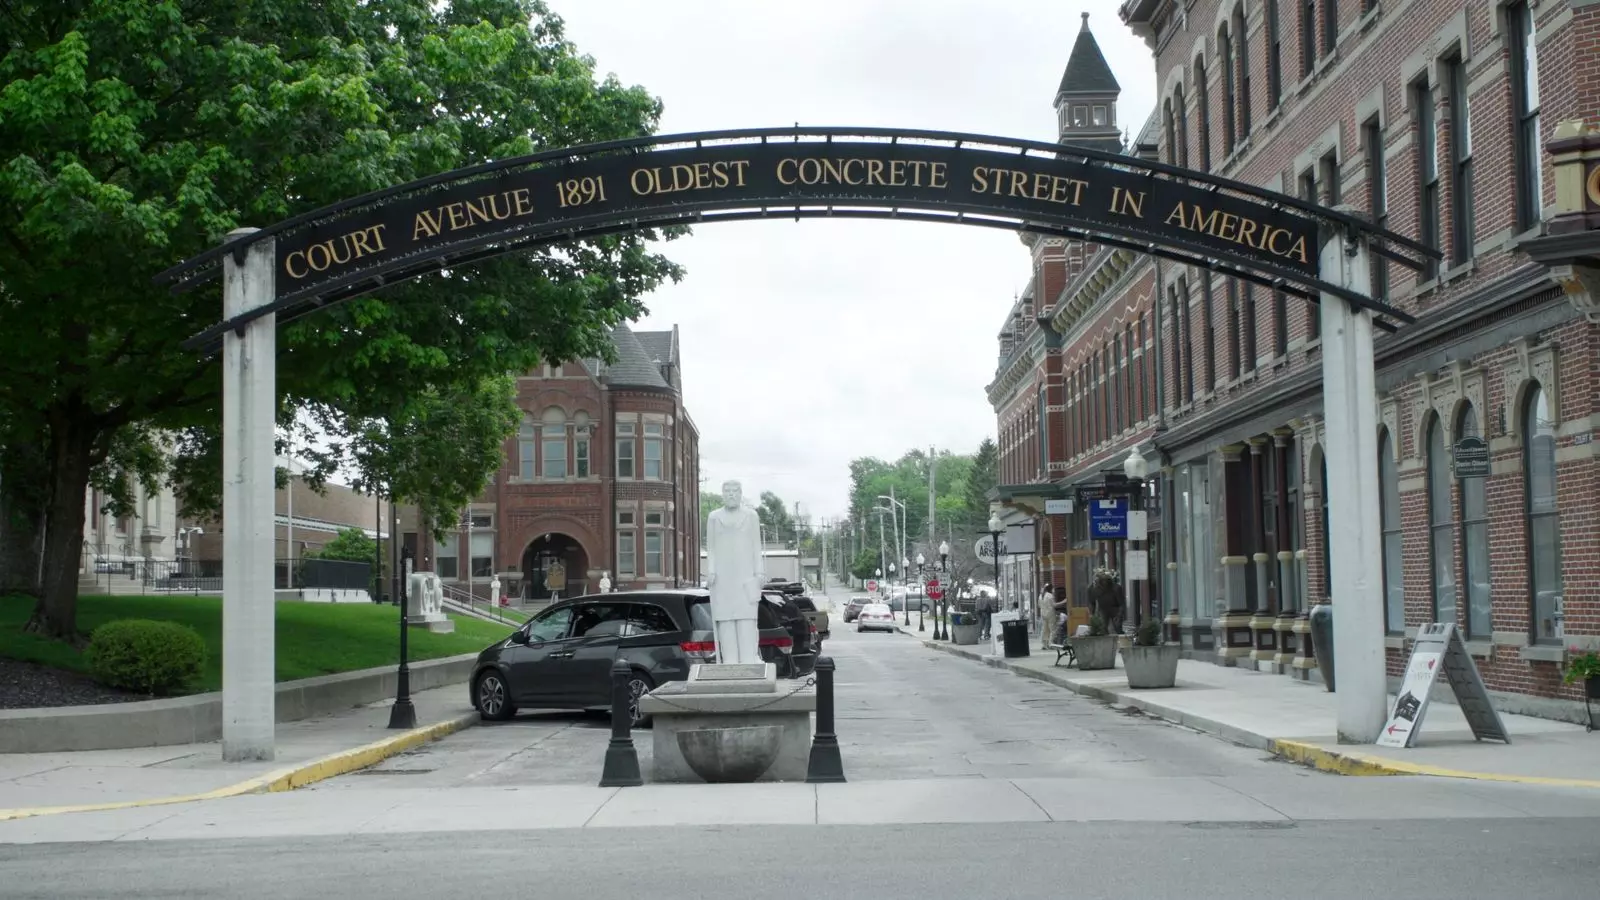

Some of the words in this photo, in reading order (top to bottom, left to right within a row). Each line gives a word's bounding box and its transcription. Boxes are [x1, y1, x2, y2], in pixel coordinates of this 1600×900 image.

[285, 223, 386, 279] COURT
[412, 188, 534, 241] AVENUE
[556, 175, 608, 208] 1891
[630, 159, 750, 195] OLDEST
[776, 158, 949, 189] CONCRETE
[971, 166, 1089, 206] STREET
[1108, 186, 1147, 219] IN
[1164, 200, 1309, 264] AMERICA
[983, 540, 1004, 548] SWET
